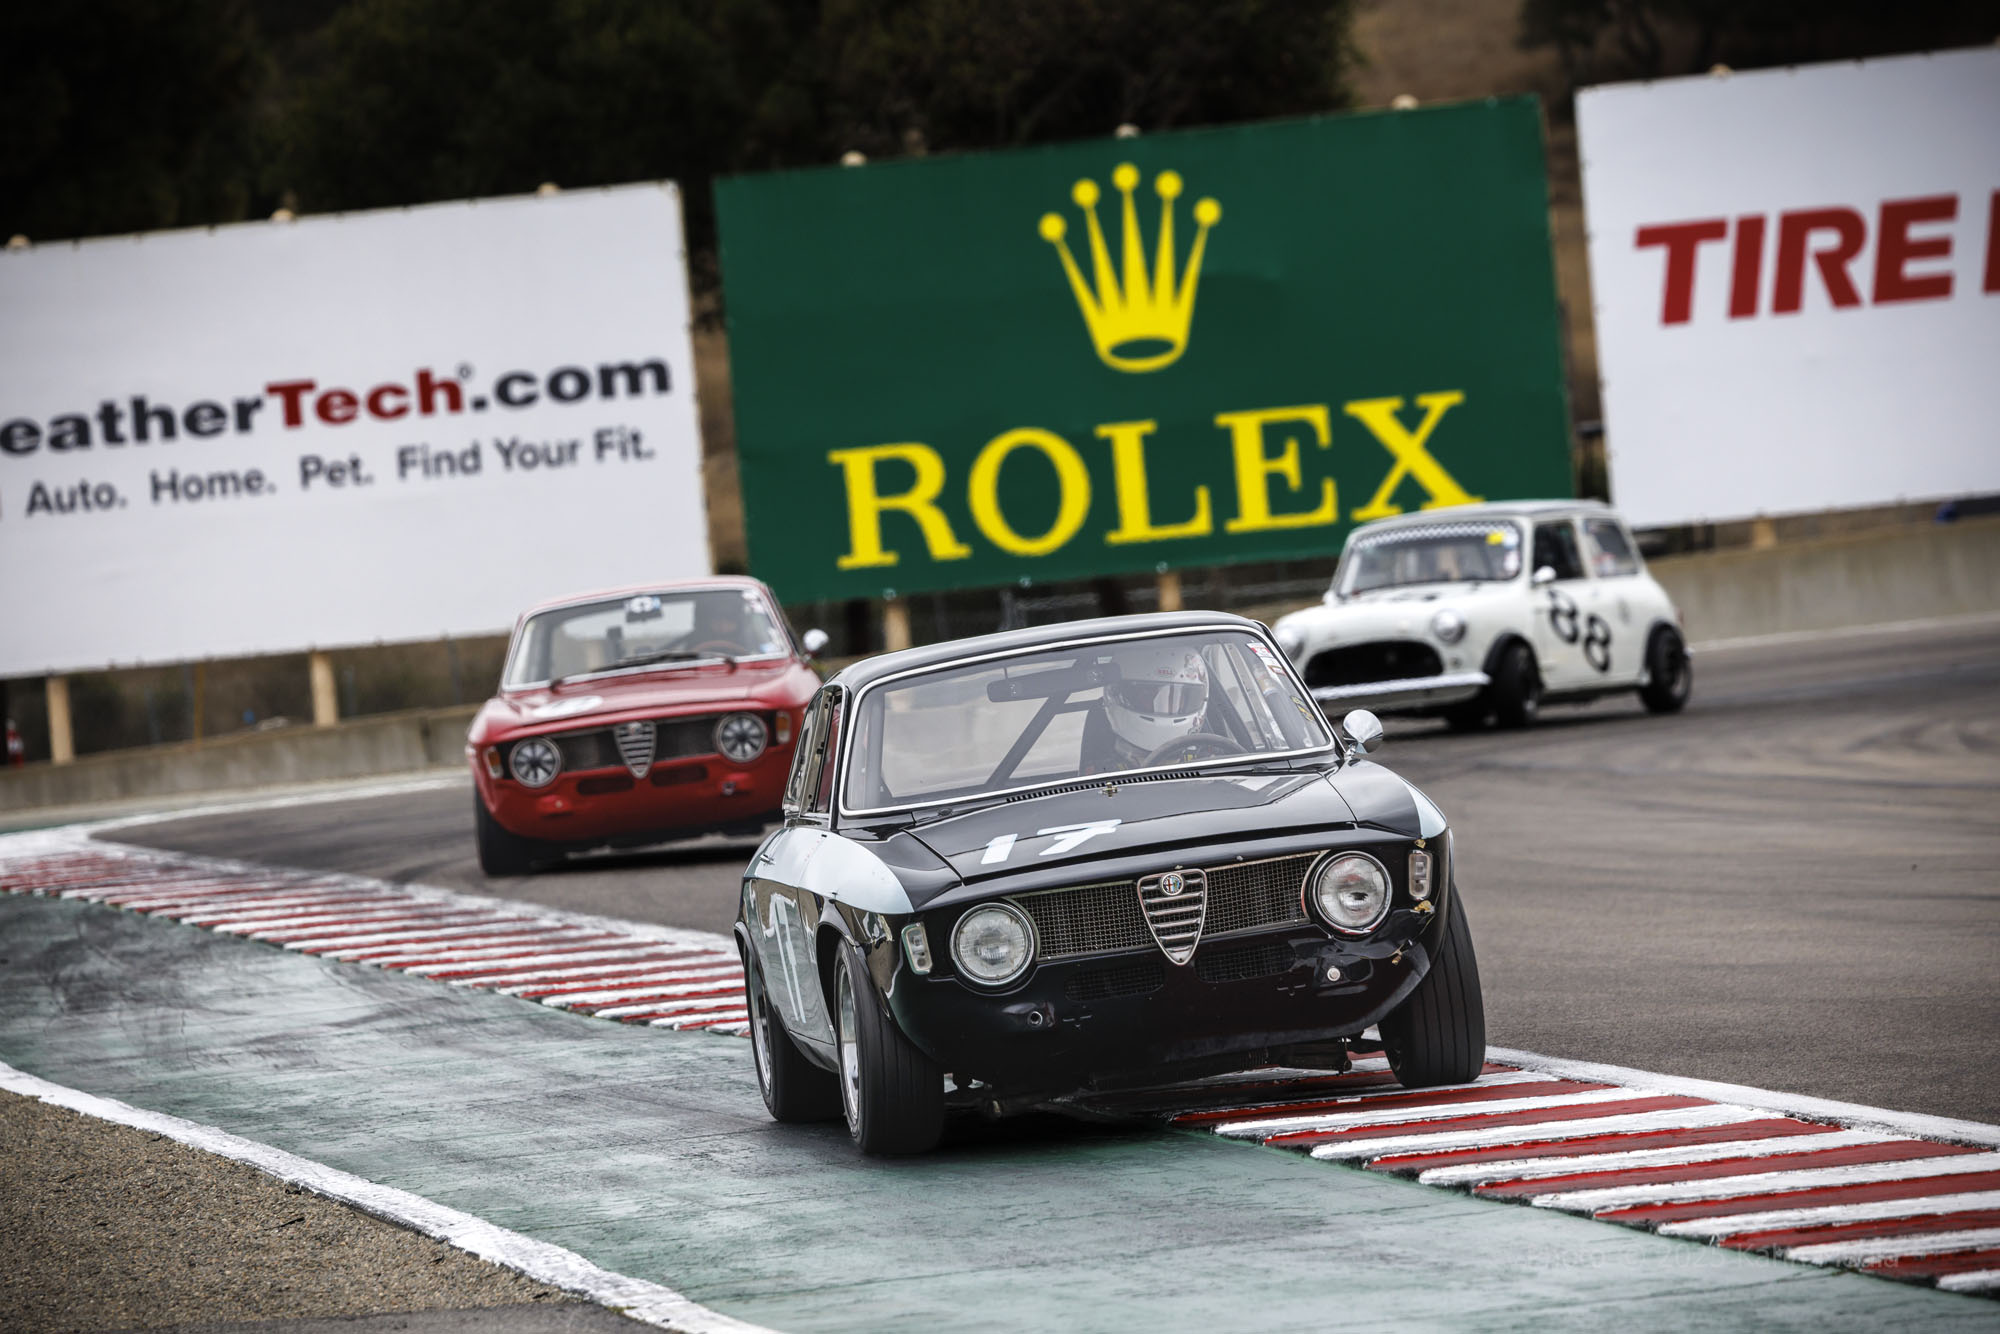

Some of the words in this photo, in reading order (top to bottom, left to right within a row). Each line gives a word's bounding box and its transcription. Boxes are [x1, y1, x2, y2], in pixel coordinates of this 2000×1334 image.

[1634, 192, 1959, 326] TIRE
[25, 479, 127, 517] Auto.
[150, 467, 276, 504] Home.
[299, 452, 374, 489] Pet.
[396, 439, 482, 480] Find
[493, 435, 582, 472] Your
[593, 425, 655, 463] Fit.
[828, 391, 1485, 570] ROLEX
[1547, 588, 1612, 673] 88
[981, 818, 1122, 865] 17
